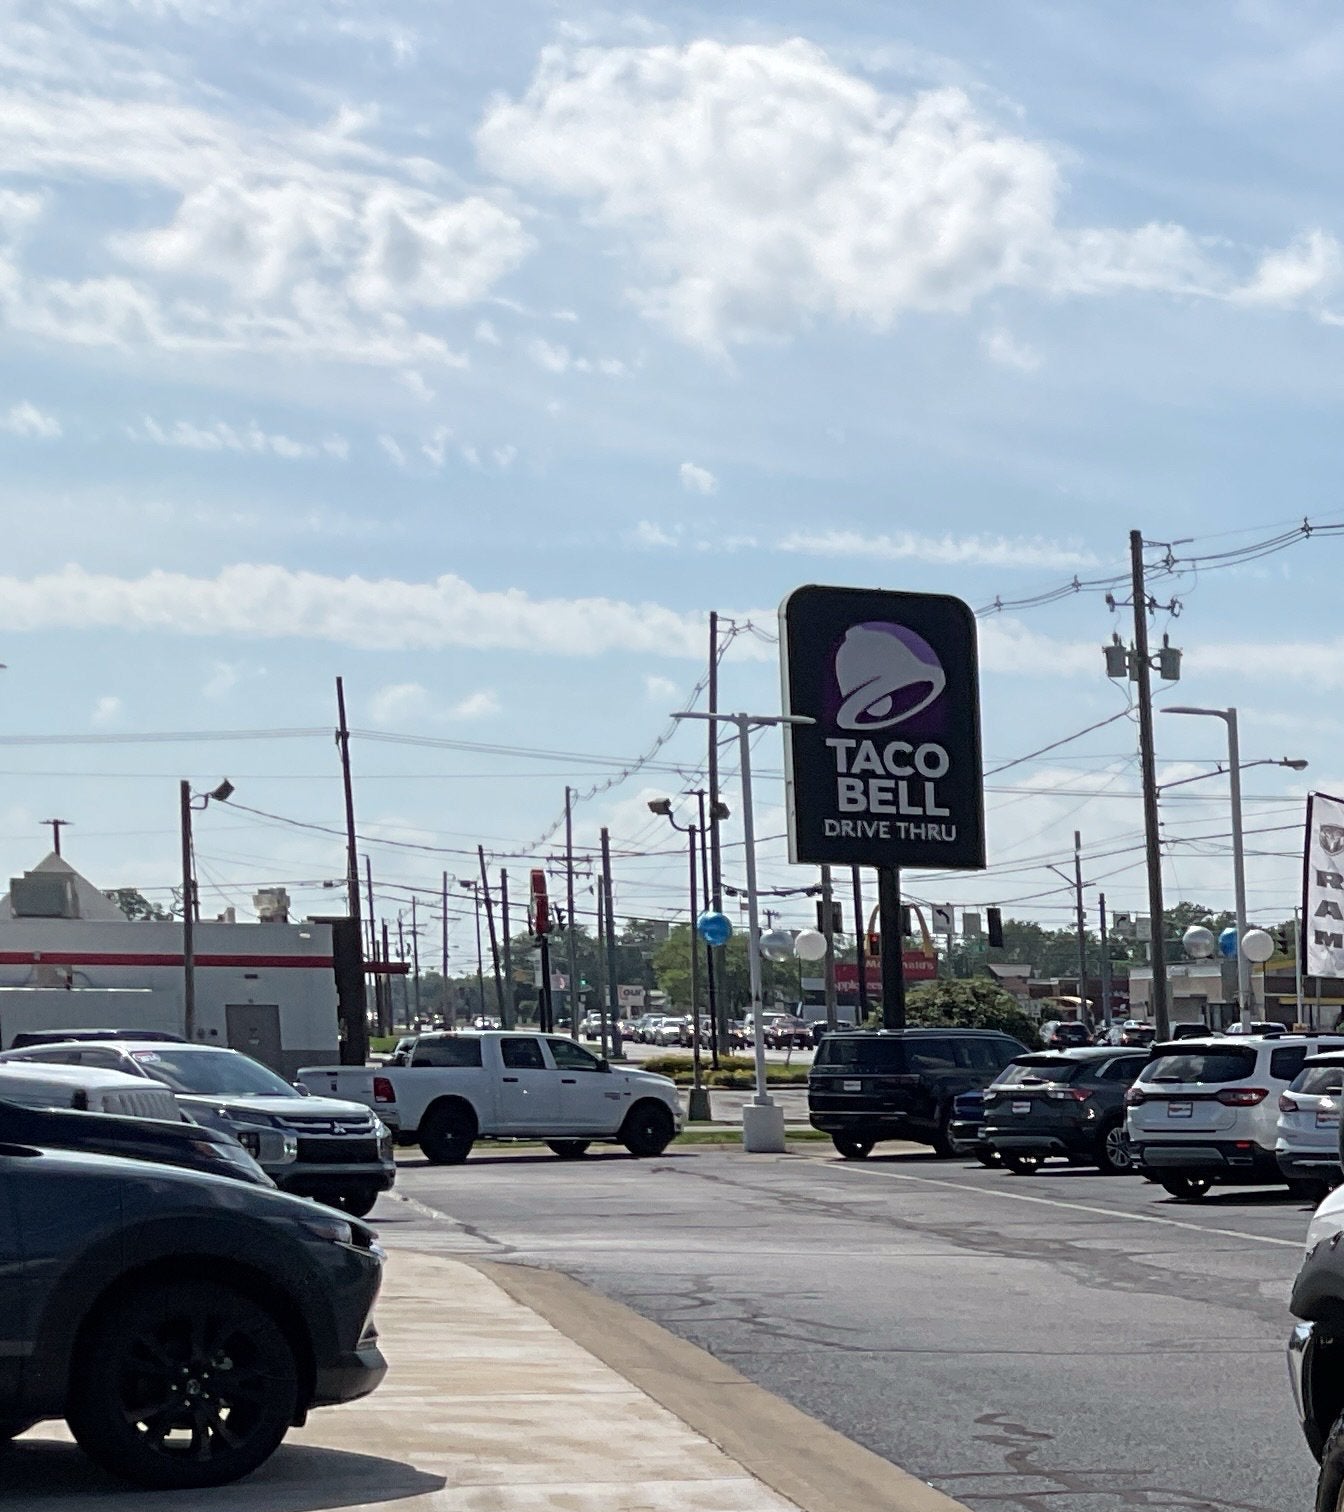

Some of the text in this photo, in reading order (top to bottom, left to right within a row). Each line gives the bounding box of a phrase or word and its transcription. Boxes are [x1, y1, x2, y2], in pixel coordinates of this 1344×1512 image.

[825, 737, 950, 779] TACO
[837, 776, 950, 817] BELL
[824, 818, 957, 842] DRIVE THRU
[1314, 869, 1344, 949] RAM
